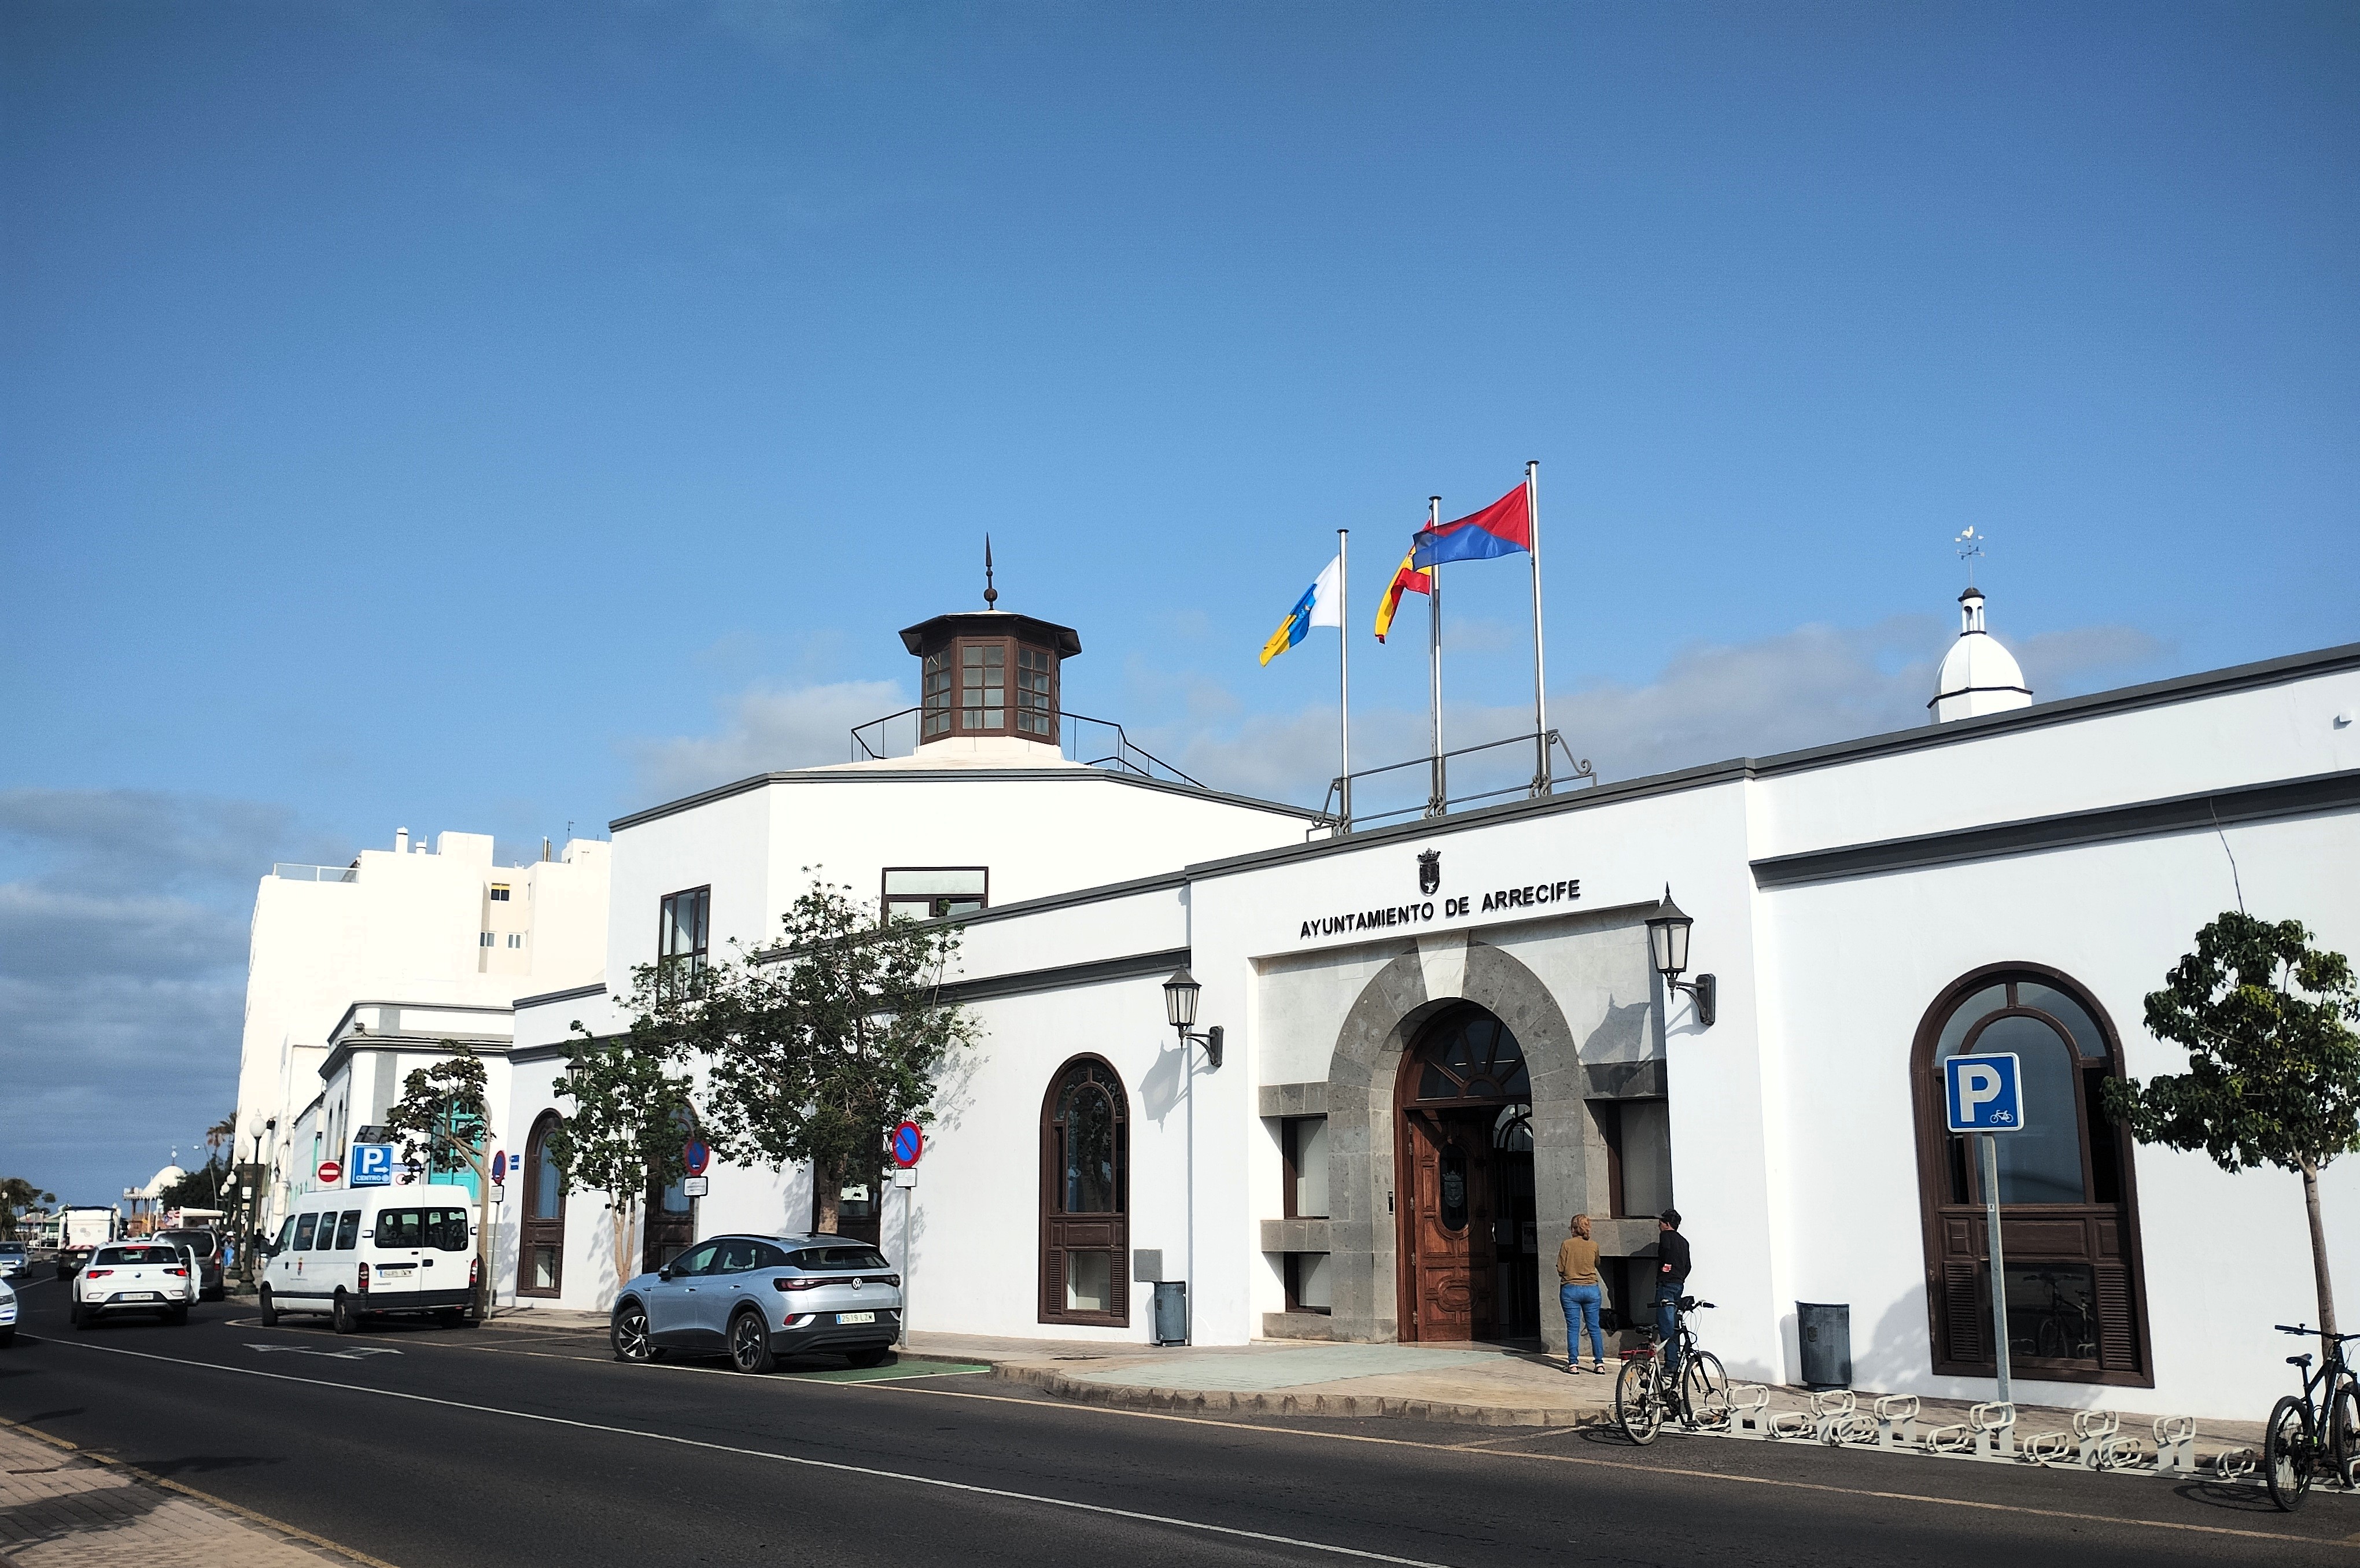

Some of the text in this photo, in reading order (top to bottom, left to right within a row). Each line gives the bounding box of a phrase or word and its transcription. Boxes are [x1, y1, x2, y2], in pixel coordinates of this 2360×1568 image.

[1300, 879, 1581, 939] AYUNTAMIENTO DE ARRECIFE
[1957, 1064, 2001, 1122] P
[362, 1148, 384, 1174] P
[842, 1314, 858, 1323] 2519
